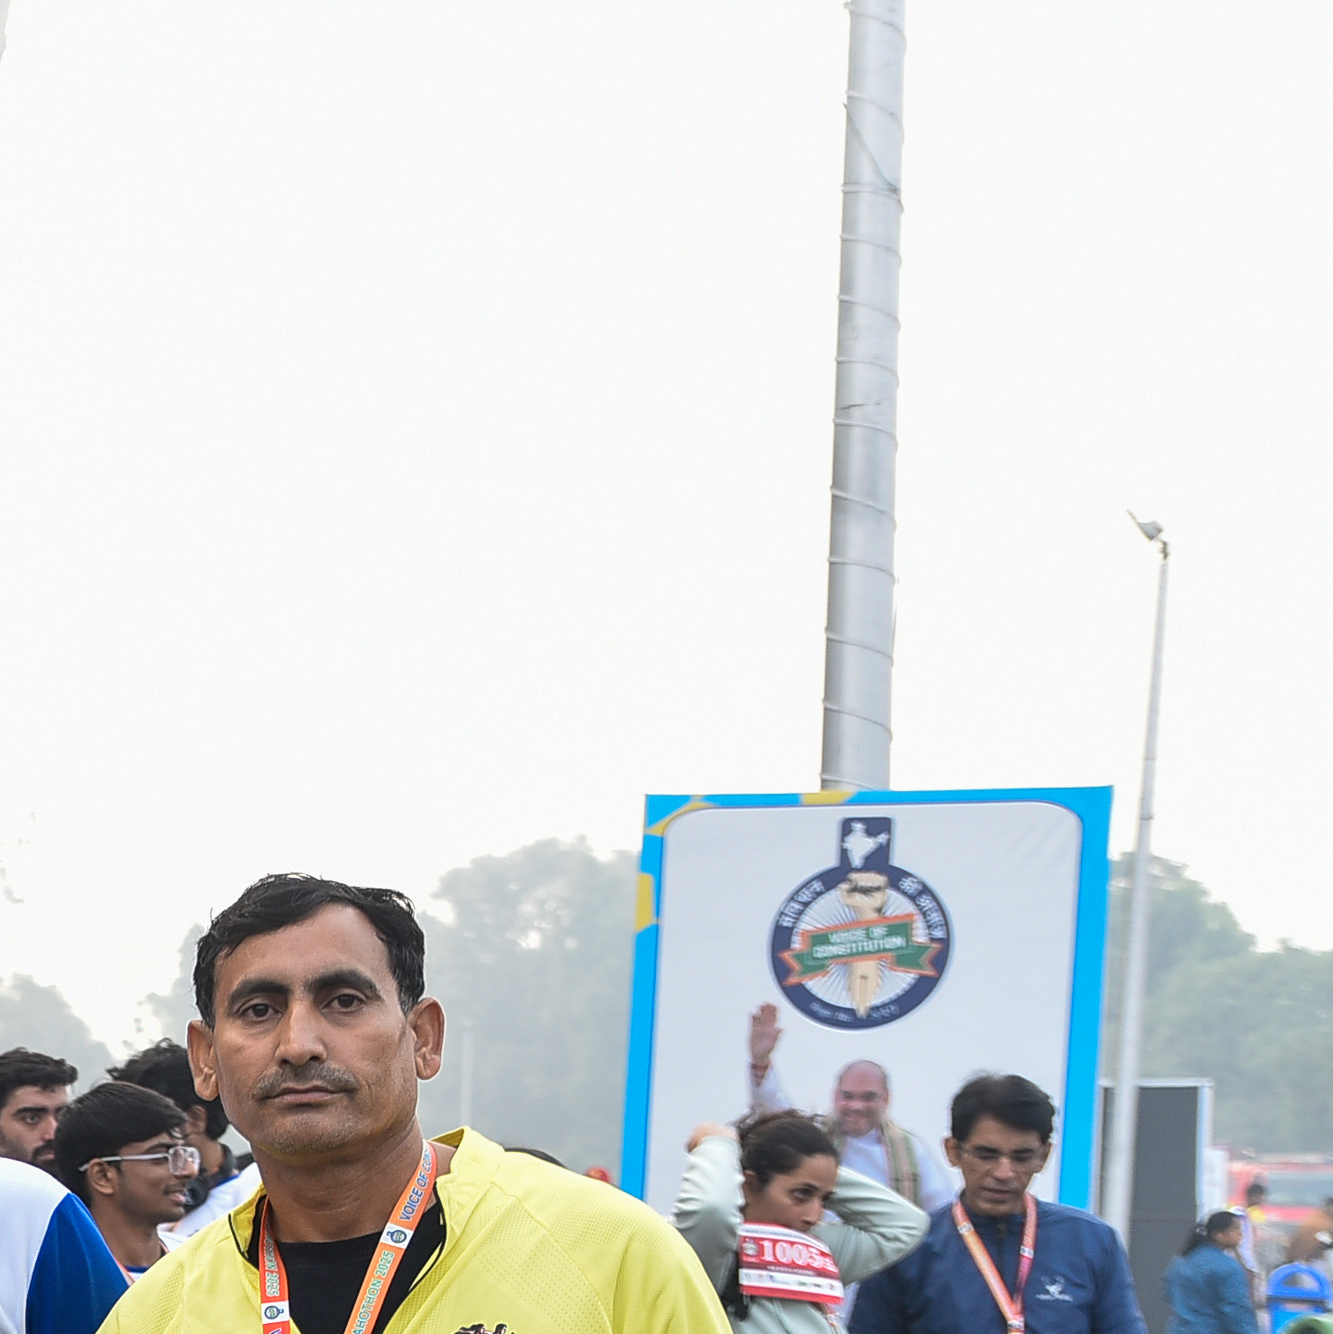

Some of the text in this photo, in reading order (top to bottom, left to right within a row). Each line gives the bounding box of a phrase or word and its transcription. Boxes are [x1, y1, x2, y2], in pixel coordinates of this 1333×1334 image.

[399, 1187, 423, 1222] VOICE
[416, 1171, 431, 1189] OF
[375, 1251, 395, 1277] 2025
[266, 1271, 280, 1298] 2025
